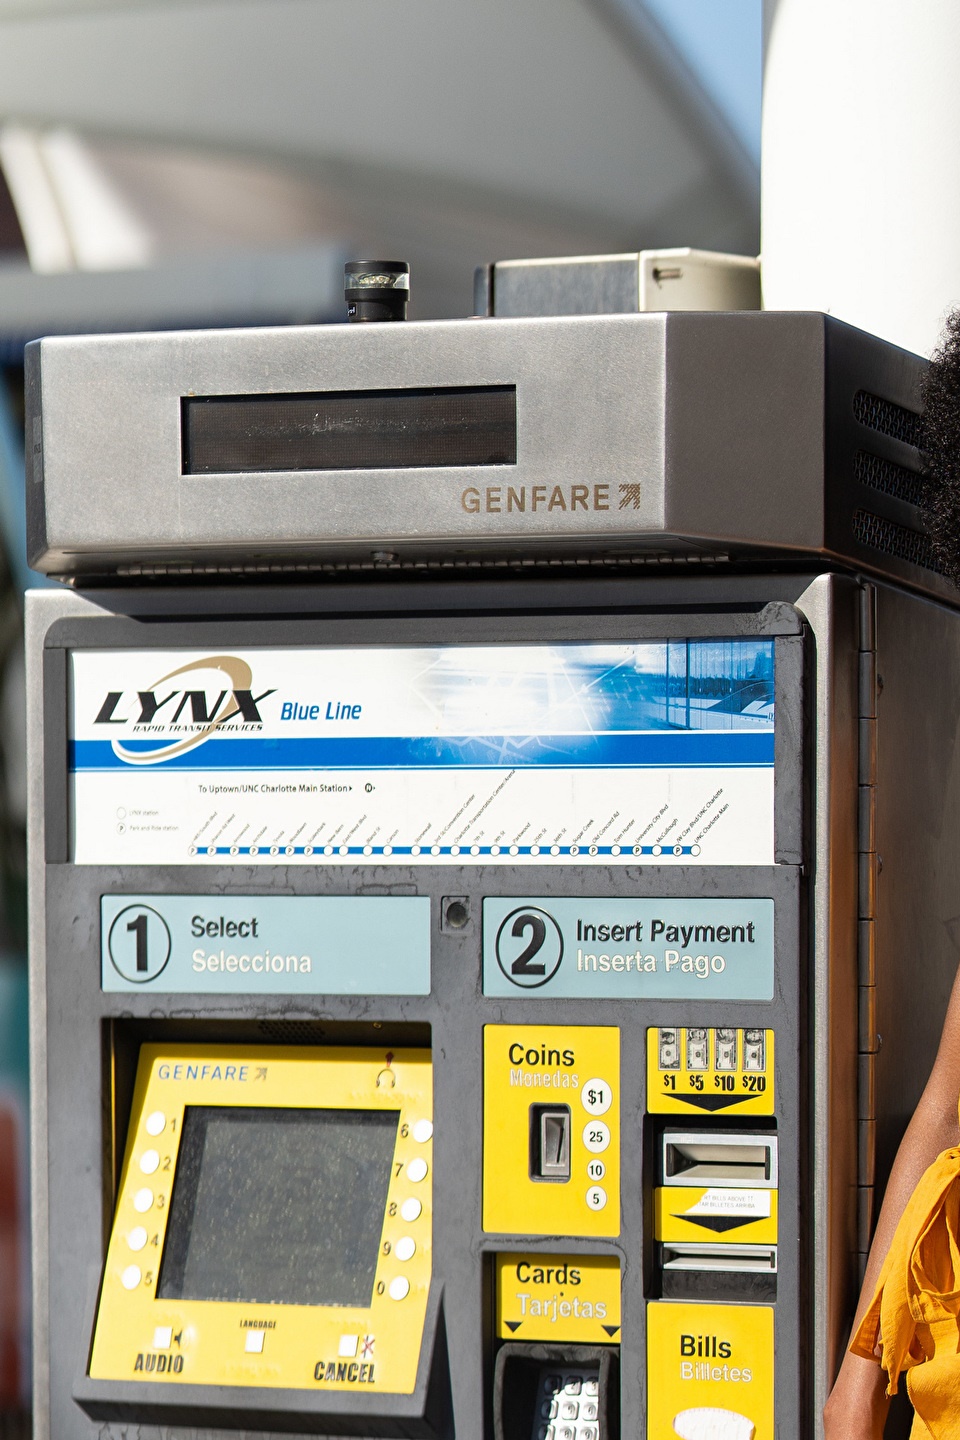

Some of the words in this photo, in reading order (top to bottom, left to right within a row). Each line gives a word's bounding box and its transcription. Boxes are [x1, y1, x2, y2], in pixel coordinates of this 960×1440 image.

[460, 482, 610, 514] GENFARE
[92, 688, 279, 724] LYNX
[280, 702, 320, 721] Blue
[325, 702, 362, 720] Line
[132, 725, 165, 733] RAPID
[168, 724, 212, 732] TRANSIT
[215, 724, 263, 732] SERVICES
[198, 785, 207, 793] To
[209, 784, 259, 796] Uptown/UNC
[261, 783, 297, 793] Charlotte
[298, 783, 318, 793] Main
[320, 783, 348, 793] Station
[191, 915, 259, 938] Select
[576, 919, 642, 942] Insert
[651, 919, 755, 949] Payment
[127, 914, 149, 972] 1
[511, 914, 546, 976] 2
[191, 949, 312, 973] Selecciona
[577, 949, 657, 973] Inserta
[665, 949, 726, 979] Pago
[508, 1043, 575, 1067] Coins
[158, 1064, 249, 1082] GENFARE
[510, 1068, 579, 1088] Monedas
[664, 1074, 676, 1091] $1
[689, 1074, 704, 1091] $5
[714, 1074, 735, 1092] $10
[742, 1074, 766, 1092] $20
[588, 1089, 604, 1105] $1
[170, 1118, 178, 1132] 1
[400, 1123, 409, 1138] 6
[589, 1130, 603, 1144] 25
[163, 1157, 172, 1171] 2
[395, 1163, 404, 1177] 7
[588, 1164, 603, 1176] 10
[156, 1195, 165, 1208] 3
[592, 1193, 599, 1205] 5
[388, 1202, 397, 1217] 8
[150, 1234, 159, 1248] 4
[383, 1241, 391, 1256] 9
[145, 1272, 153, 1286] 5
[516, 1261, 582, 1285] Cards
[516, 1293, 607, 1322] Tarjetas
[239, 1319, 277, 1329] LANGUAGE
[681, 1335, 732, 1359] Bills
[134, 1353, 184, 1374] AUDIO
[314, 1361, 375, 1384] CANCEL
[681, 1361, 752, 1383] Billetes
